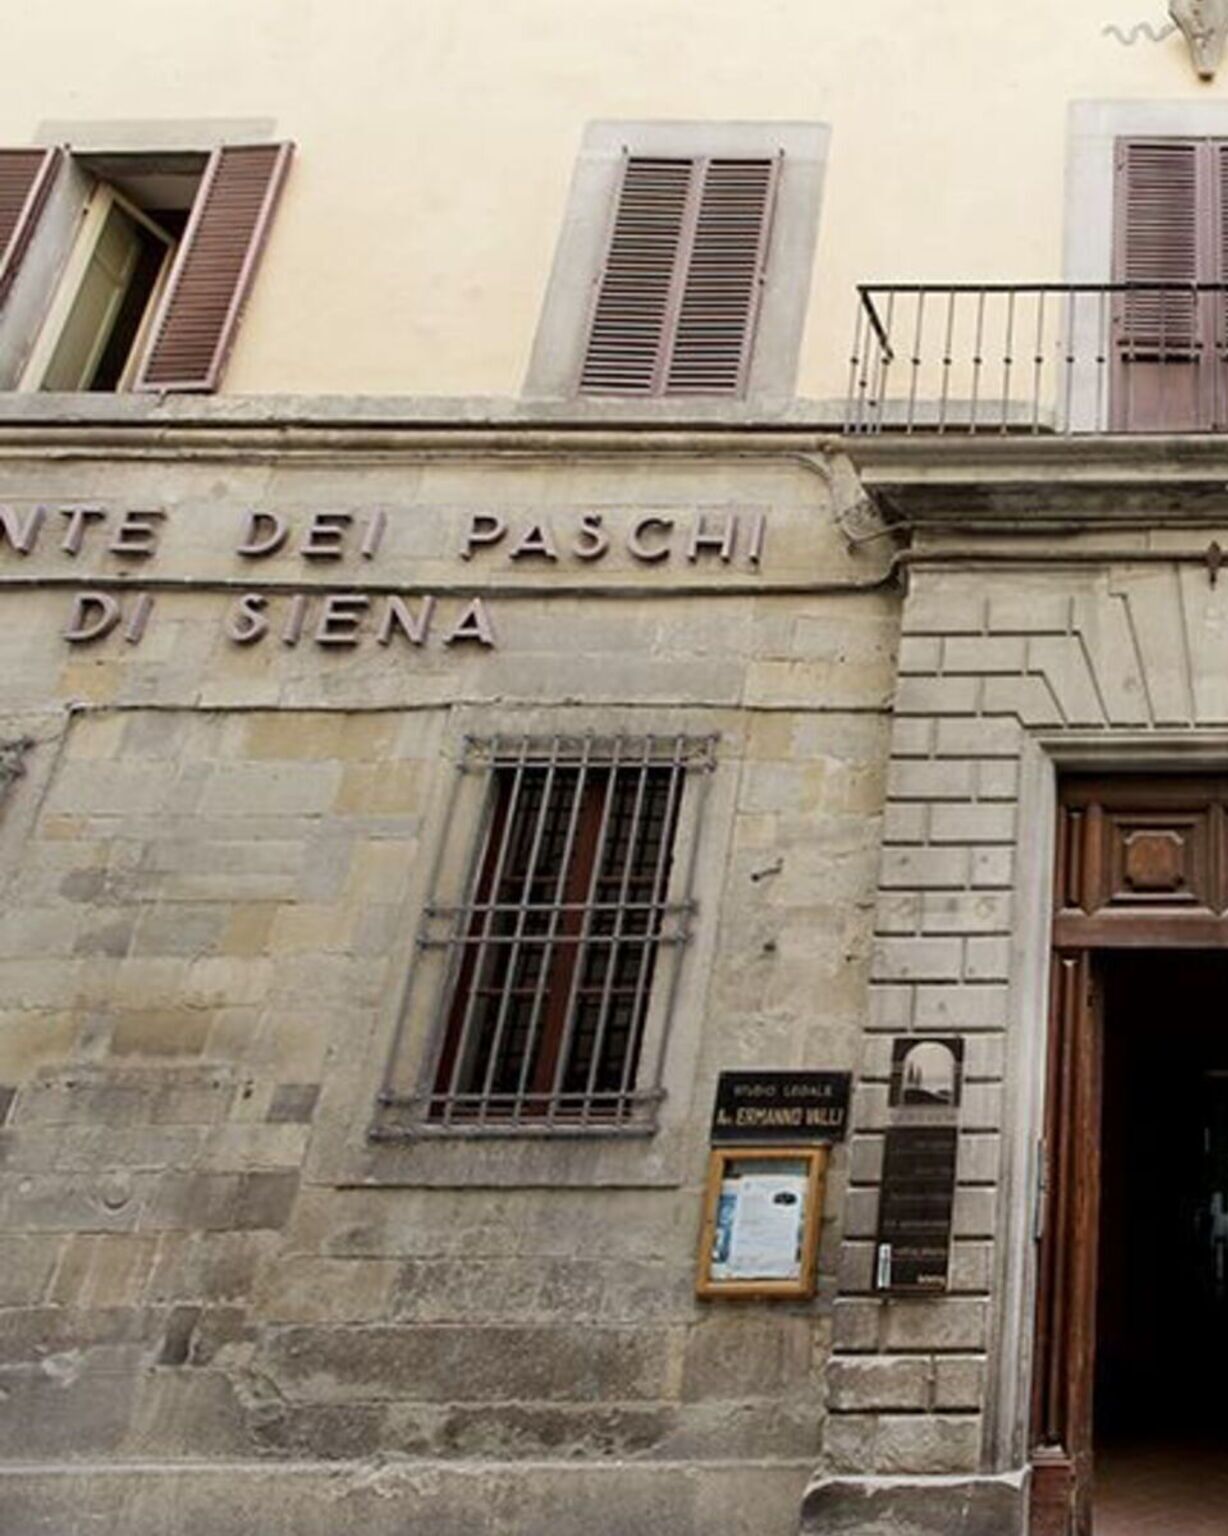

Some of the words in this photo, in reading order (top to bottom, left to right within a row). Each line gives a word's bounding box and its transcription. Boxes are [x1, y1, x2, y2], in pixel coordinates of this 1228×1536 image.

[236, 508, 387, 558] DEI
[458, 511, 767, 566] PASCHI
[63, 591, 155, 645] DI
[225, 592, 498, 650] SIENA
